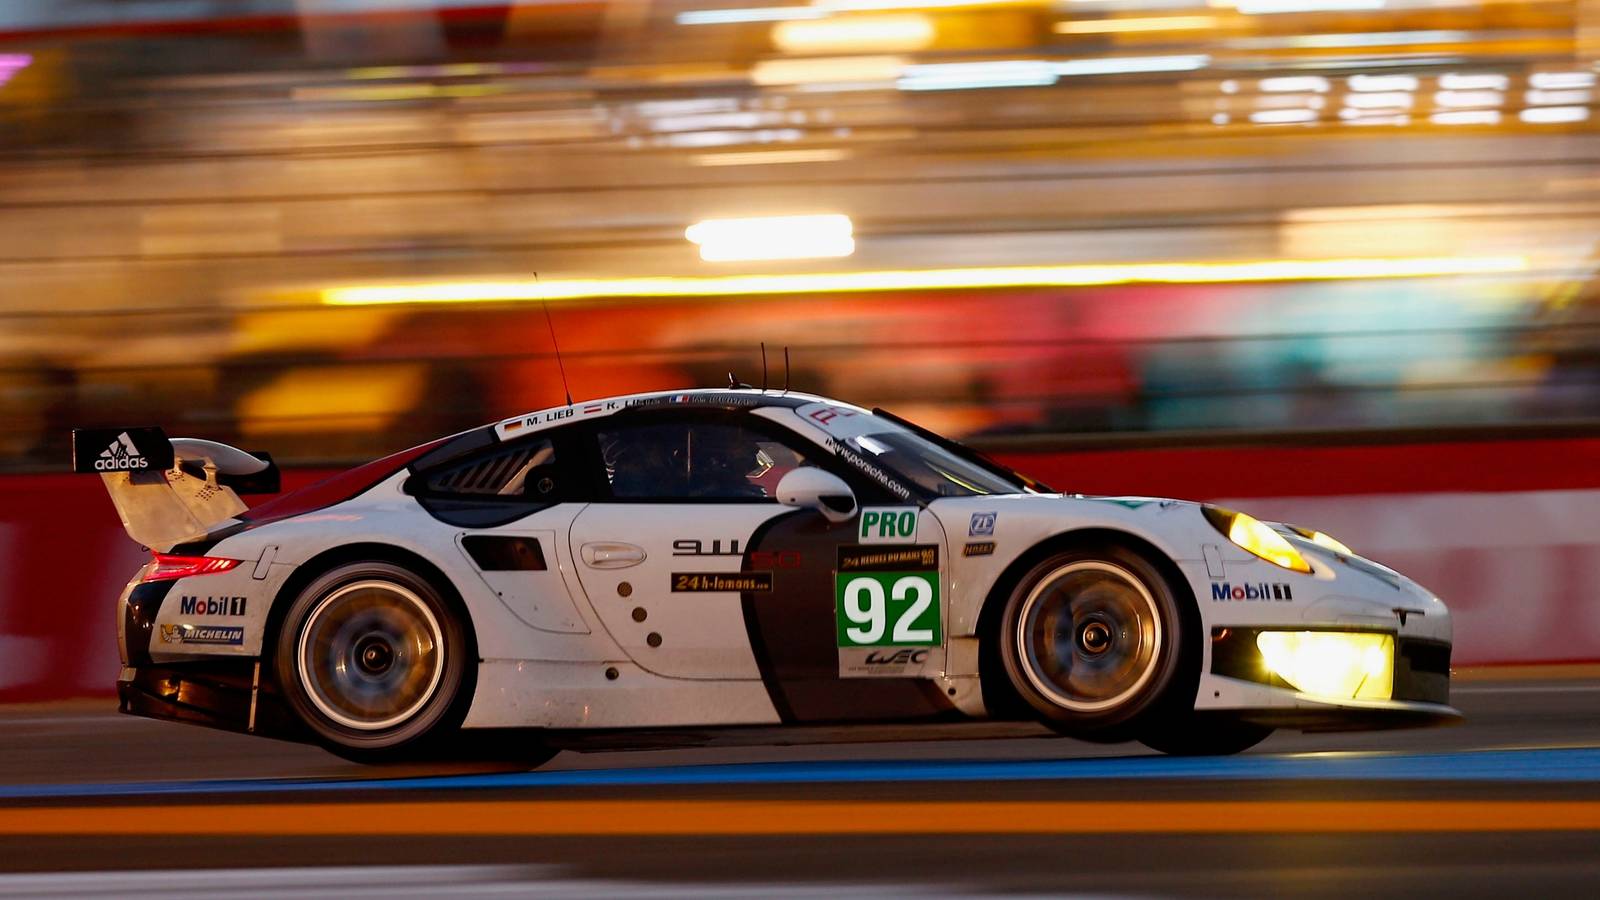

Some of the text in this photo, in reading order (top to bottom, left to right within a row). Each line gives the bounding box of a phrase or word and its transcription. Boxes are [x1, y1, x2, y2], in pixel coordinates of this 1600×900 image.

[526, 408, 574, 426] M. LIEB
[94, 456, 148, 470] adidas
[861, 511, 916, 538] PRO
[676, 575, 699, 590] 24
[1211, 582, 1270, 600] Mobil
[180, 596, 229, 615] Mobil
[844, 575, 933, 644] 92
[184, 629, 242, 640] MICHELIN
